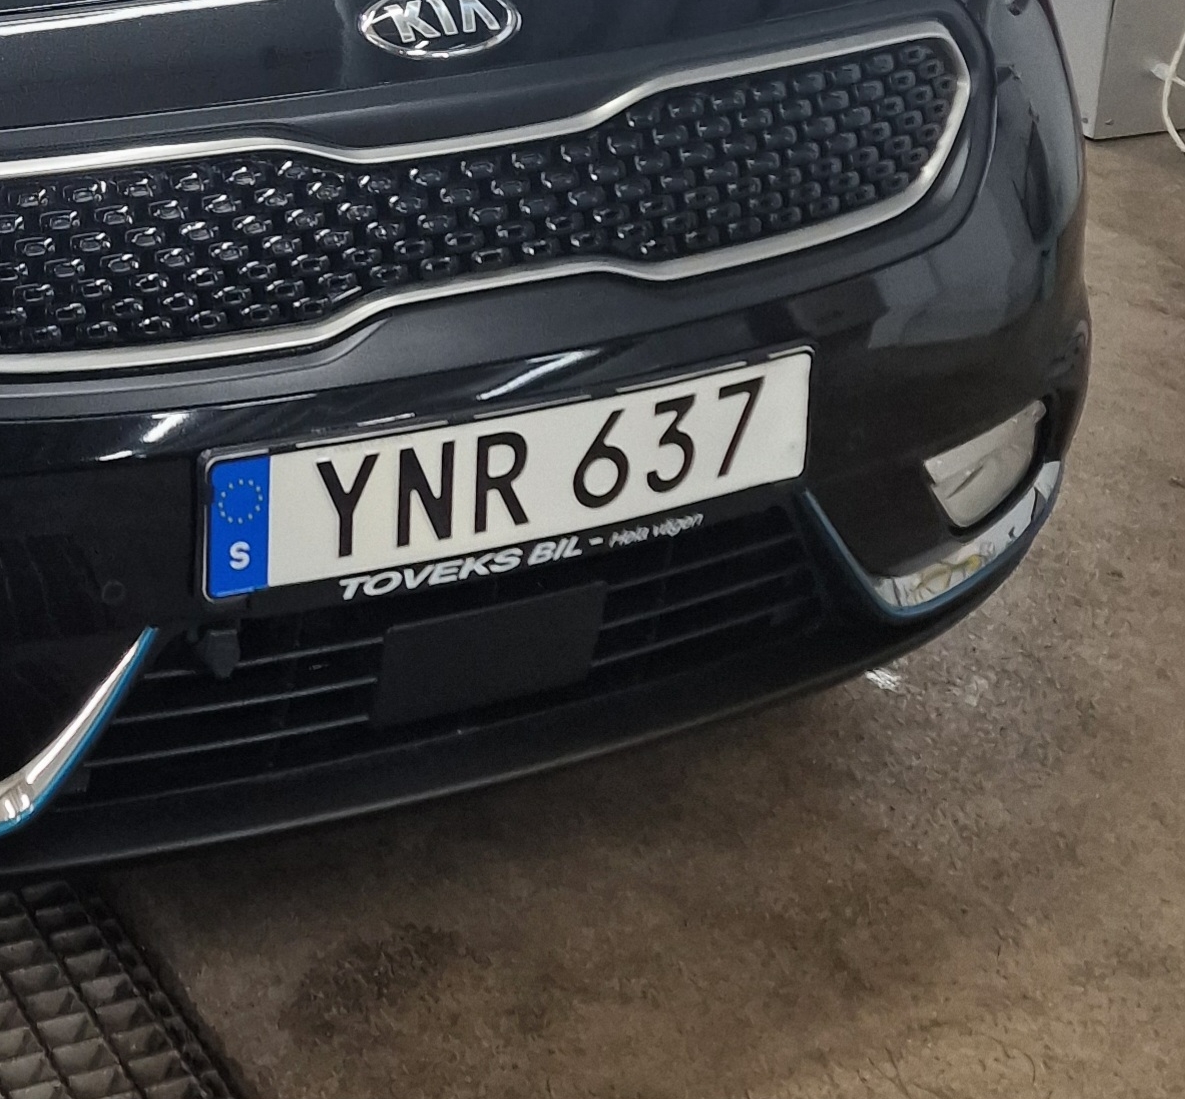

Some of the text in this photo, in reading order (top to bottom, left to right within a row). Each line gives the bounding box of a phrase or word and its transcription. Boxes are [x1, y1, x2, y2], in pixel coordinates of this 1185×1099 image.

[315, 376, 766, 558] YNR 637
[229, 540, 251, 571] S
[338, 548, 524, 600] TOVEKS
[527, 535, 583, 567] BIL
